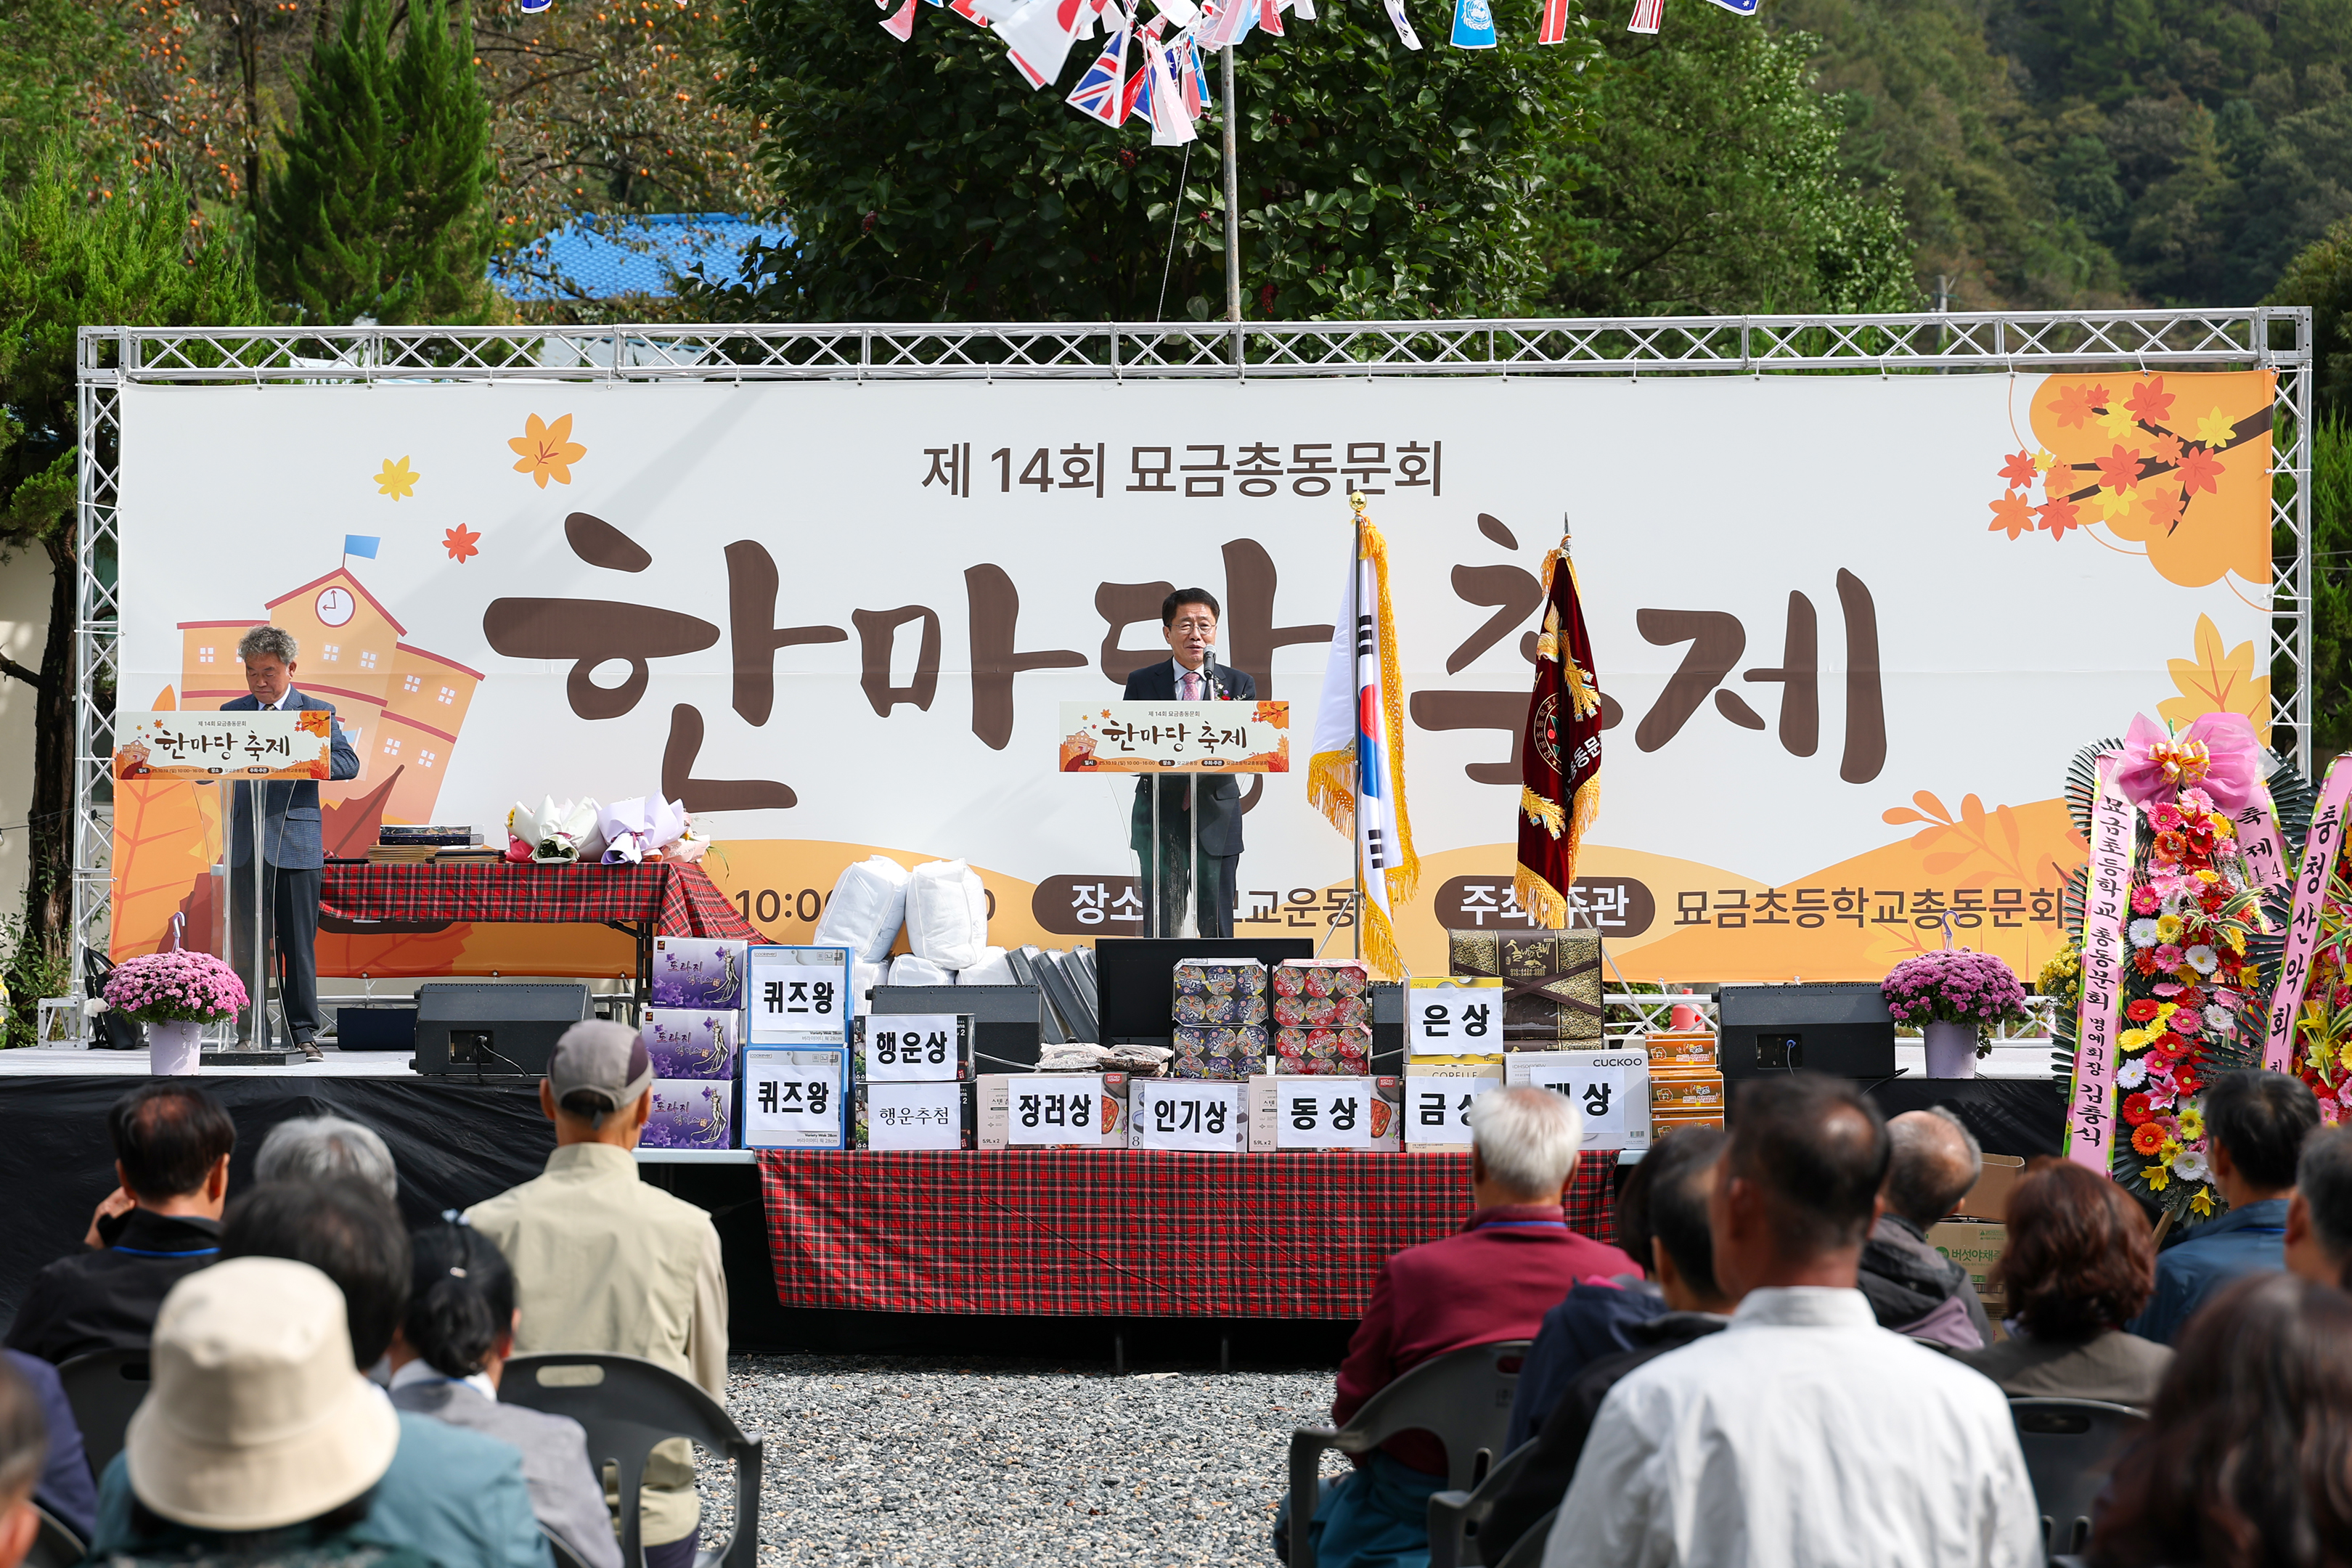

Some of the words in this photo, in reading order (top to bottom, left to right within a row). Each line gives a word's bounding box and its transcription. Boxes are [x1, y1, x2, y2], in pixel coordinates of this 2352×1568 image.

[921, 441, 971, 499] 제
[991, 441, 1106, 499] 14회
[1125, 440, 1442, 498] 묘금총동문회
[1409, 513, 1887, 785] 축제
[155, 730, 238, 760] 한마당
[244, 730, 290, 761] 축제
[1101, 719, 1191, 752] 한마당
[1198, 720, 1247, 754] 축제
[1673, 886, 2063, 928] 묘금초등학교총동문회
[2271, 805, 2337, 1046] 충청산악회
[764, 981, 834, 1014] 퀴즈왕
[1423, 1005, 1450, 1037] 은
[1461, 1003, 1490, 1037] 상
[876, 1031, 947, 1064] 행운상
[1593, 1058, 1642, 1066] CUCKOO
[758, 1081, 829, 1114] 퀴즈왕
[1018, 1094, 1091, 1127] 장려상
[1291, 1098, 1318, 1130] 동
[1329, 1097, 1357, 1130] 상
[1419, 1093, 1446, 1126] 금
[1583, 1082, 1612, 1116] 상
[879, 1106, 948, 1126] 행운추첨
[1154, 1099, 1227, 1134] 인기상
[1132, 1136, 1140, 1146] 8
